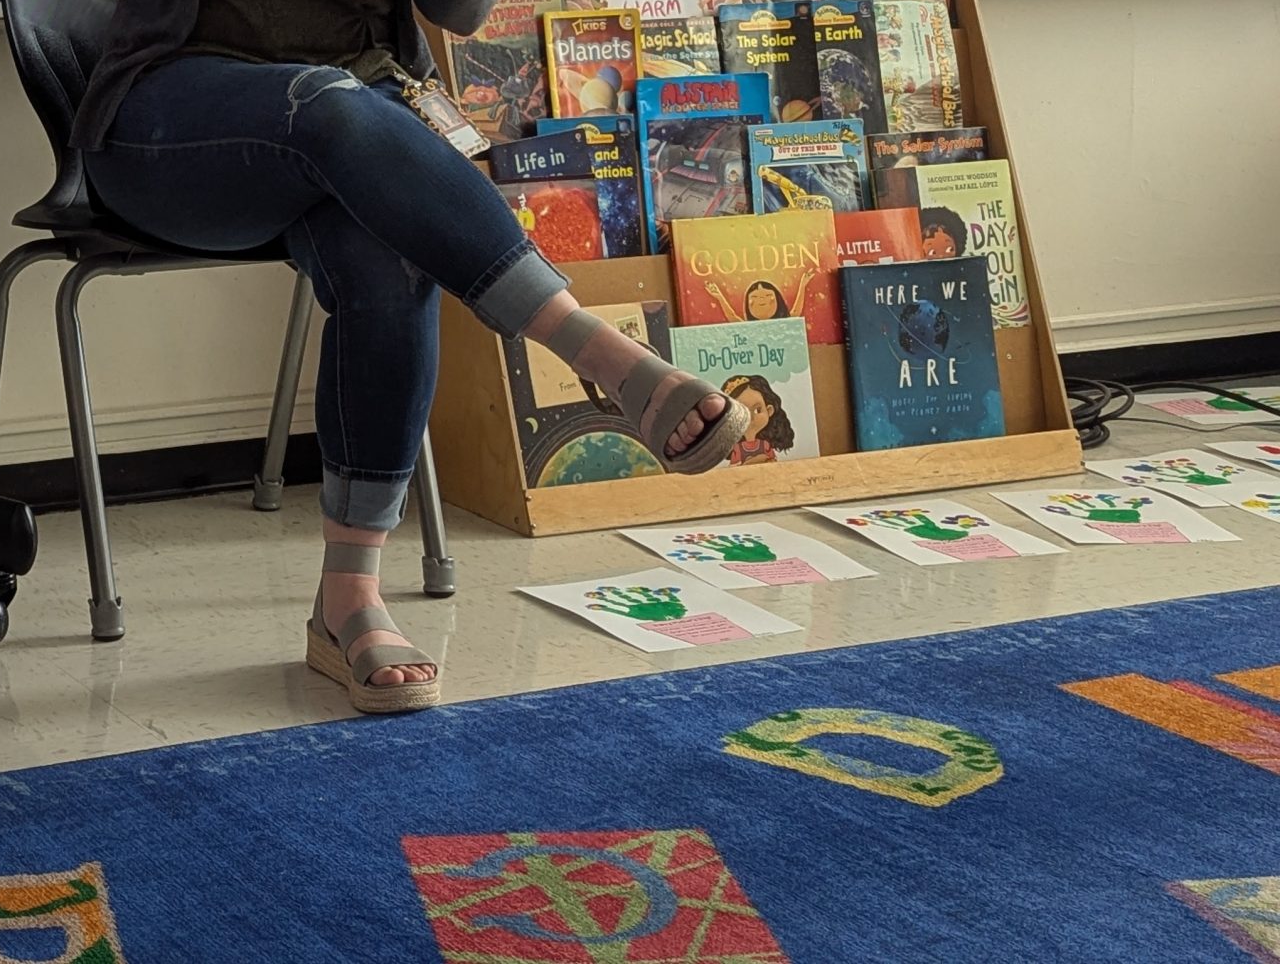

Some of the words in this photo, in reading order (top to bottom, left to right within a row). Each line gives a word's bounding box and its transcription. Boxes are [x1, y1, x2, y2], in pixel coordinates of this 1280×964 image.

[582, 21, 607, 31] KIDS
[623, 16, 633, 27] 2
[737, 34, 760, 48] The
[762, 34, 797, 47] Solar
[825, 26, 863, 41] Earth
[556, 36, 632, 62] Planets
[746, 51, 791, 67] System
[793, 132, 822, 146] School
[823, 131, 839, 143] Bus
[874, 140, 899, 156] The
[902, 137, 936, 154] Solar
[938, 135, 983, 152] System
[515, 151, 547, 174] Life
[550, 148, 566, 166] in
[594, 146, 620, 161] and
[927, 173, 965, 184] JACQUELINE
[966, 172, 998, 182] WOODSON
[977, 200, 1006, 221] THE
[970, 220, 1008, 250] DAY
[836, 243, 846, 255] A
[847, 240, 882, 255] LITTLE
[690, 241, 822, 278] GOLDEN
[875, 285, 919, 306] HERE
[942, 281, 968, 301] WE
[732, 334, 748, 348] The
[698, 347, 754, 373] Do-Over
[758, 343, 786, 367] Day
[899, 357, 959, 389] ARE
